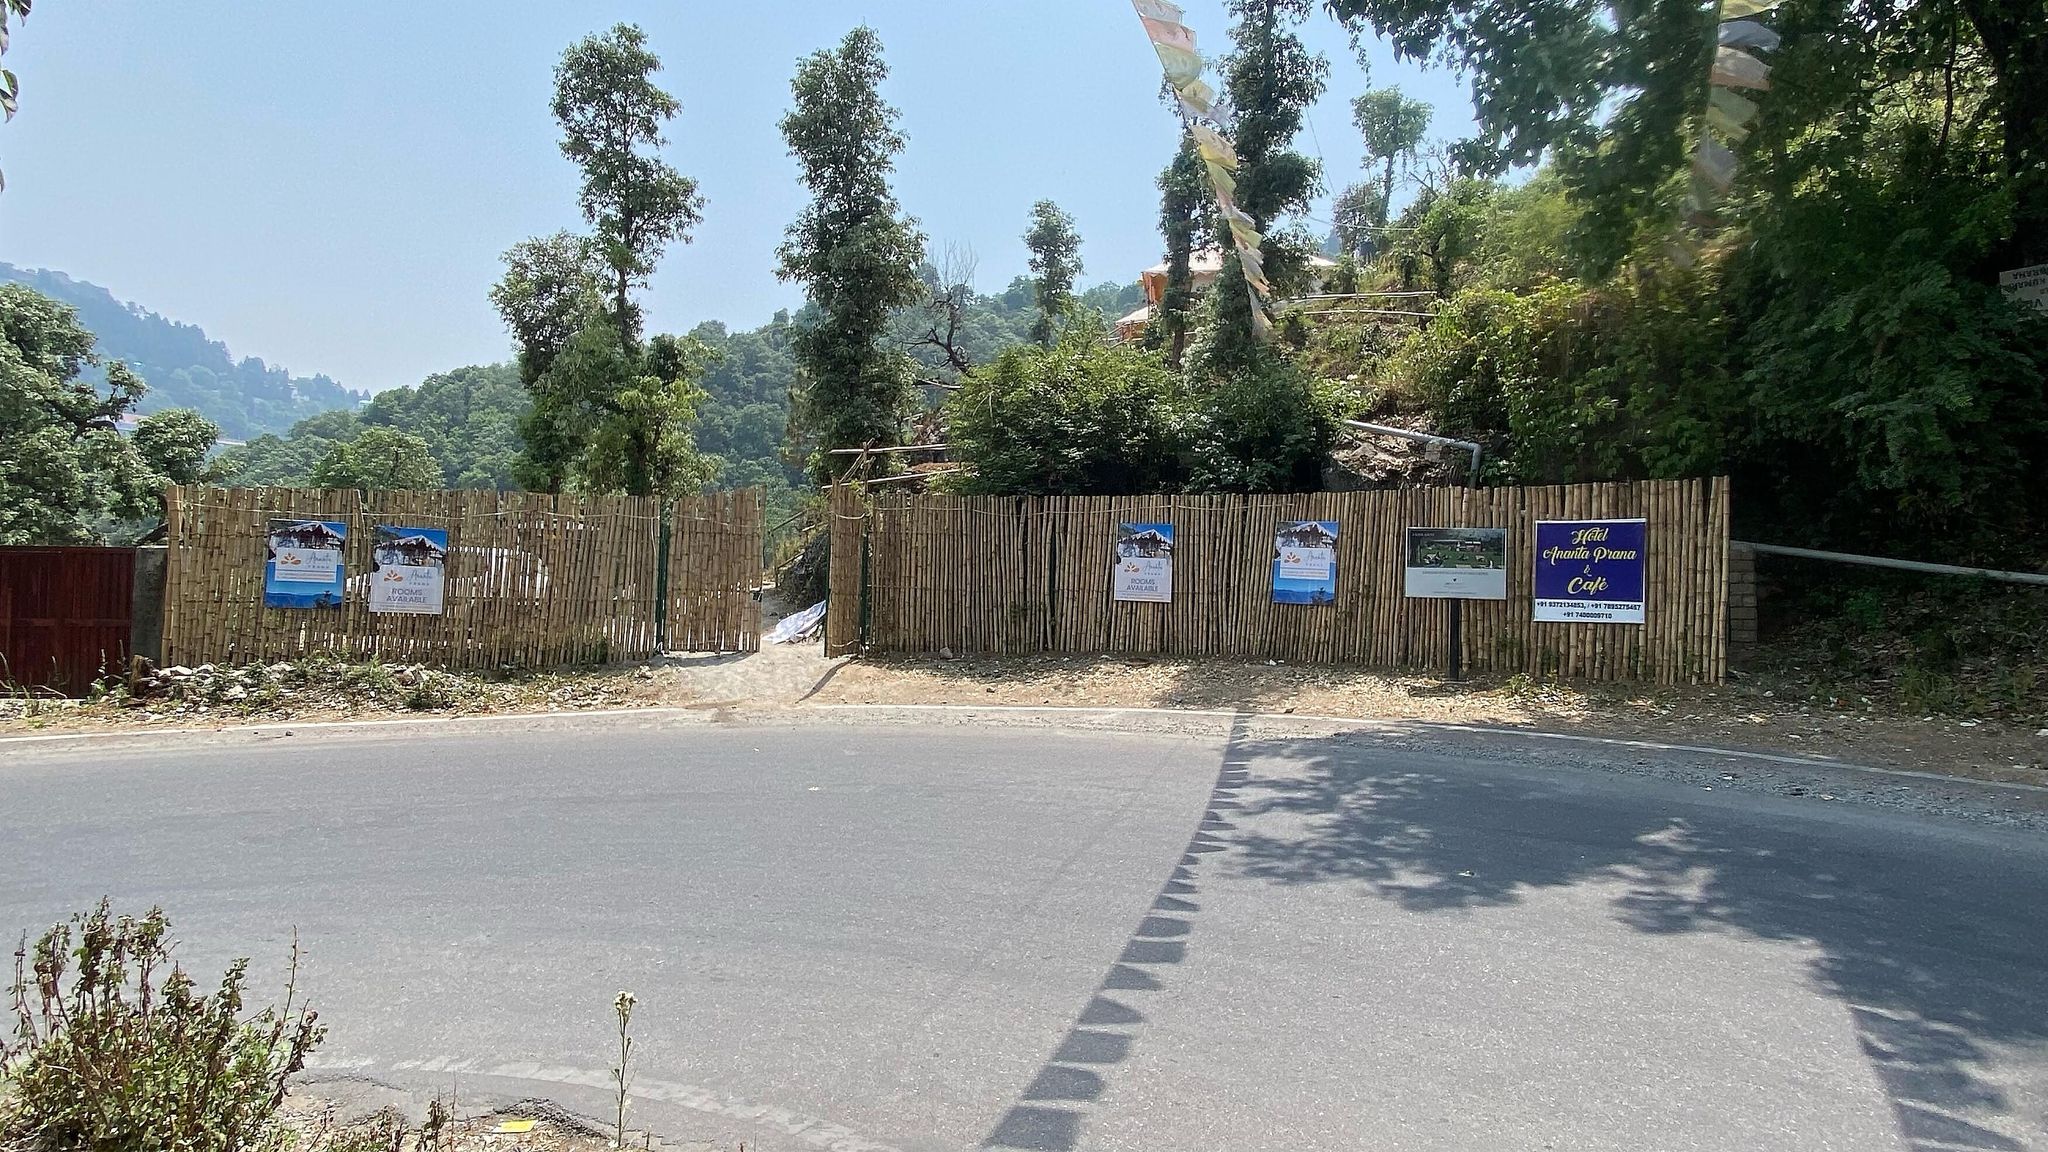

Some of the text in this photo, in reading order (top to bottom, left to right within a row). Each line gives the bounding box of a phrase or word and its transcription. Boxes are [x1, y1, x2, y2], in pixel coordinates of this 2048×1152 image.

[1571, 527, 1609, 545] Hotel
[1543, 546, 1638, 566] Ananta Prana
[1583, 564, 1592, 577] &
[391, 588, 423, 596] ROOMS
[1567, 576, 1609, 595] Café
[386, 595, 428, 604] AVAILABLE
